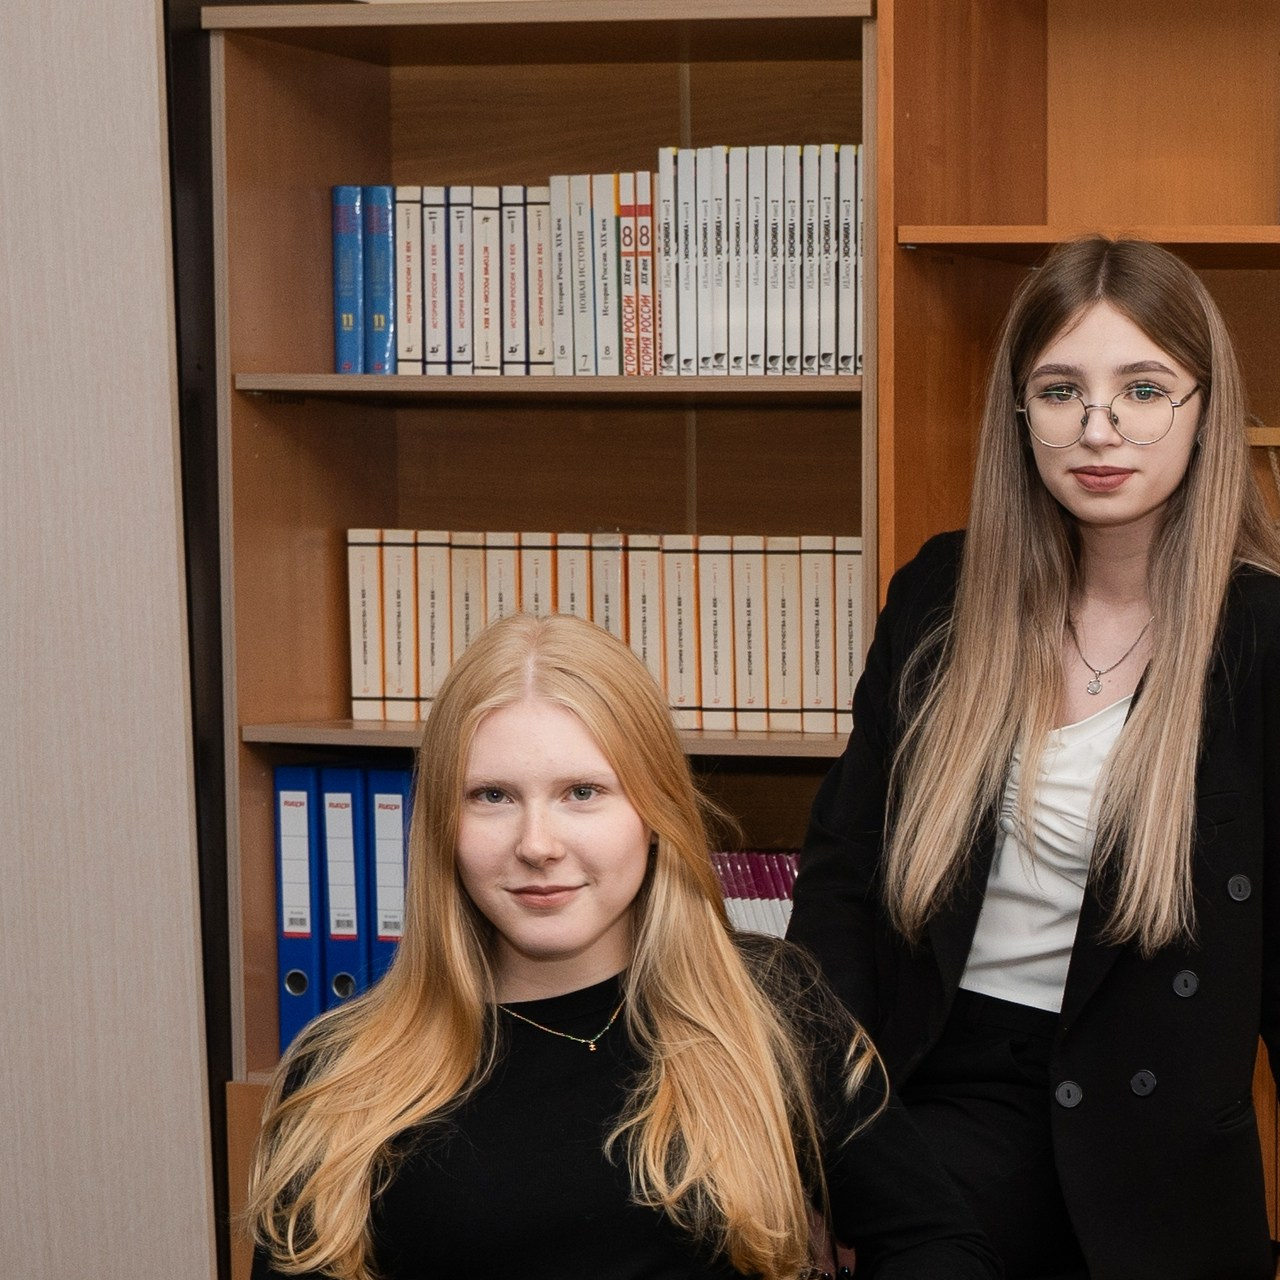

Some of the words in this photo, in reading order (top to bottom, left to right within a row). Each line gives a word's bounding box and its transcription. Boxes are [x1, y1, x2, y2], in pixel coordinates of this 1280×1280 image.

[428, 211, 437, 220] 11
[456, 210, 464, 220] 11
[507, 210, 516, 220] 11
[622, 227, 632, 246] 8
[640, 225, 650, 246] 8
[577, 231, 586, 278] ИСТОРИЯ
[578, 280, 587, 313] НОВАЯ
[342, 314, 354, 326] 11
[374, 314, 385, 326] 11
[624, 295, 634, 333] РОССИИ
[640, 295, 651, 333] РОССИИ
[559, 345, 565, 355] 8
[604, 346, 610, 355] 8
[582, 355, 588, 366] 7
